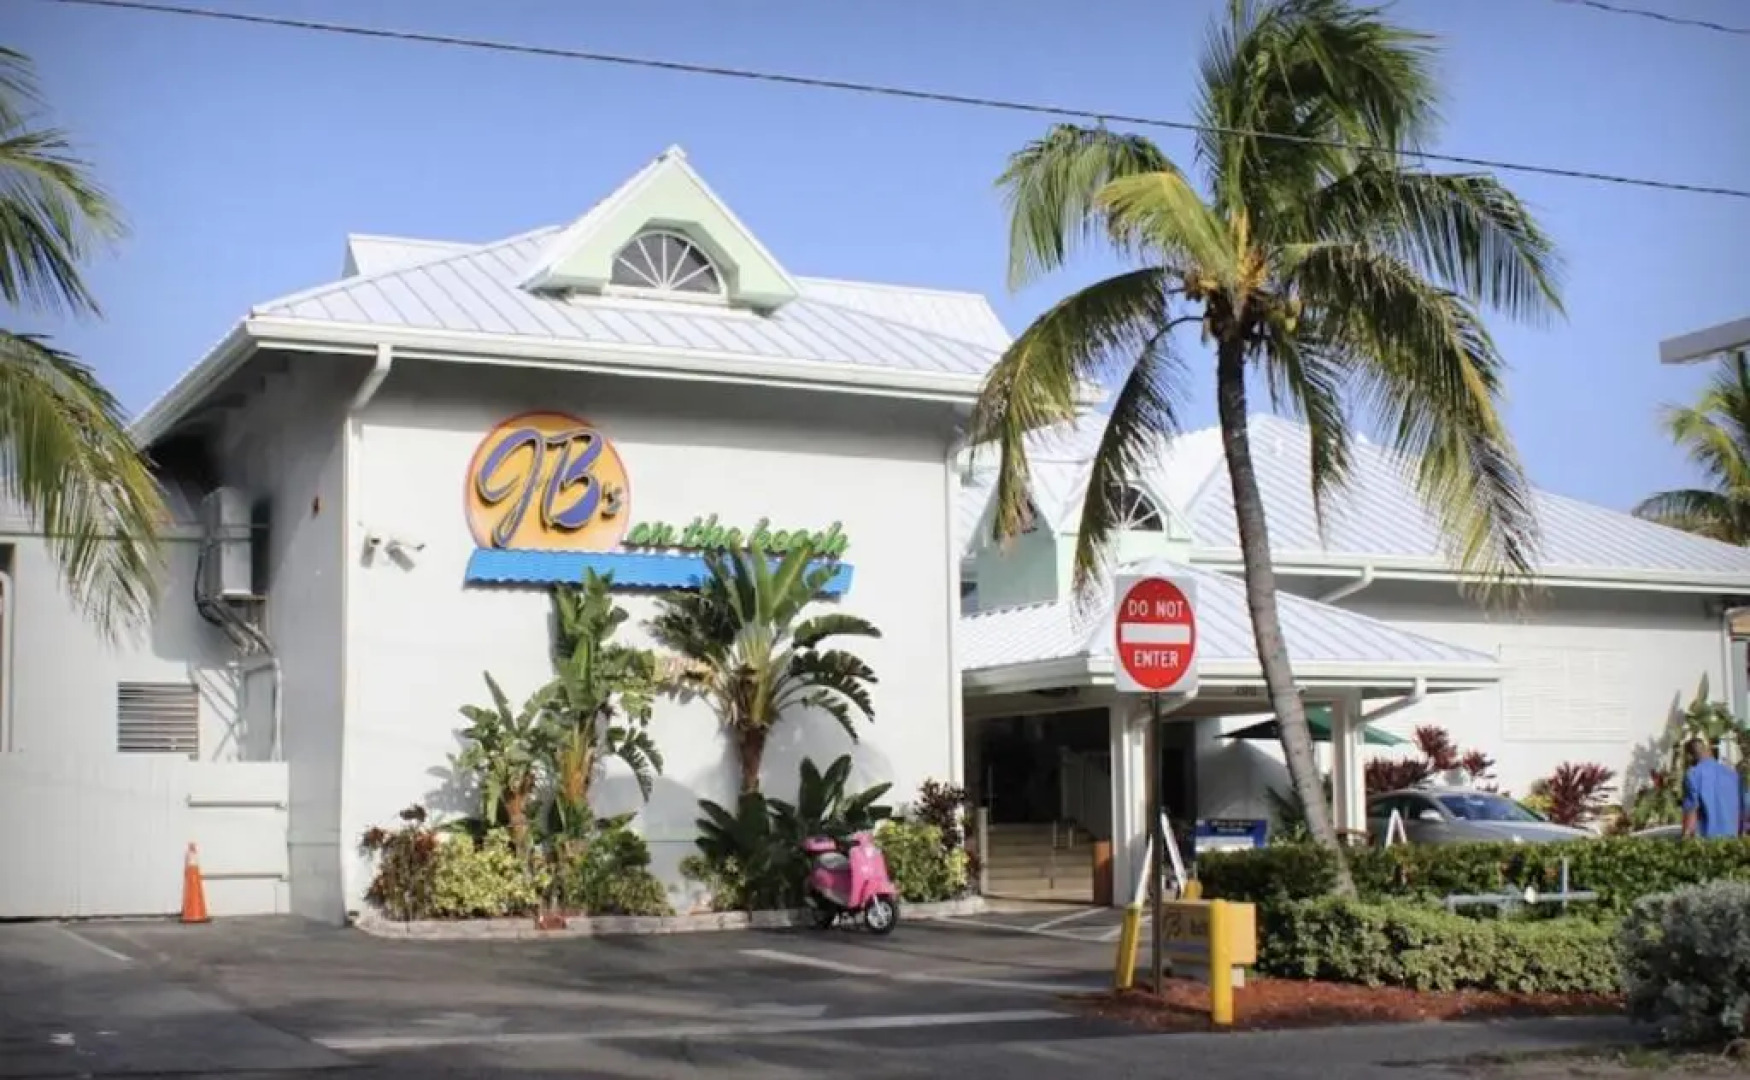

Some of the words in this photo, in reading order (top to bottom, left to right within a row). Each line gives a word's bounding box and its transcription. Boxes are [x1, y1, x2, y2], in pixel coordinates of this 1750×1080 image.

[627, 522, 674, 545] on
[681, 513, 742, 548] the
[750, 516, 848, 553] beach
[1128, 600, 1148, 616] DO
[1156, 601, 1184, 617] NOT
[1134, 650, 1179, 668] ENTER
